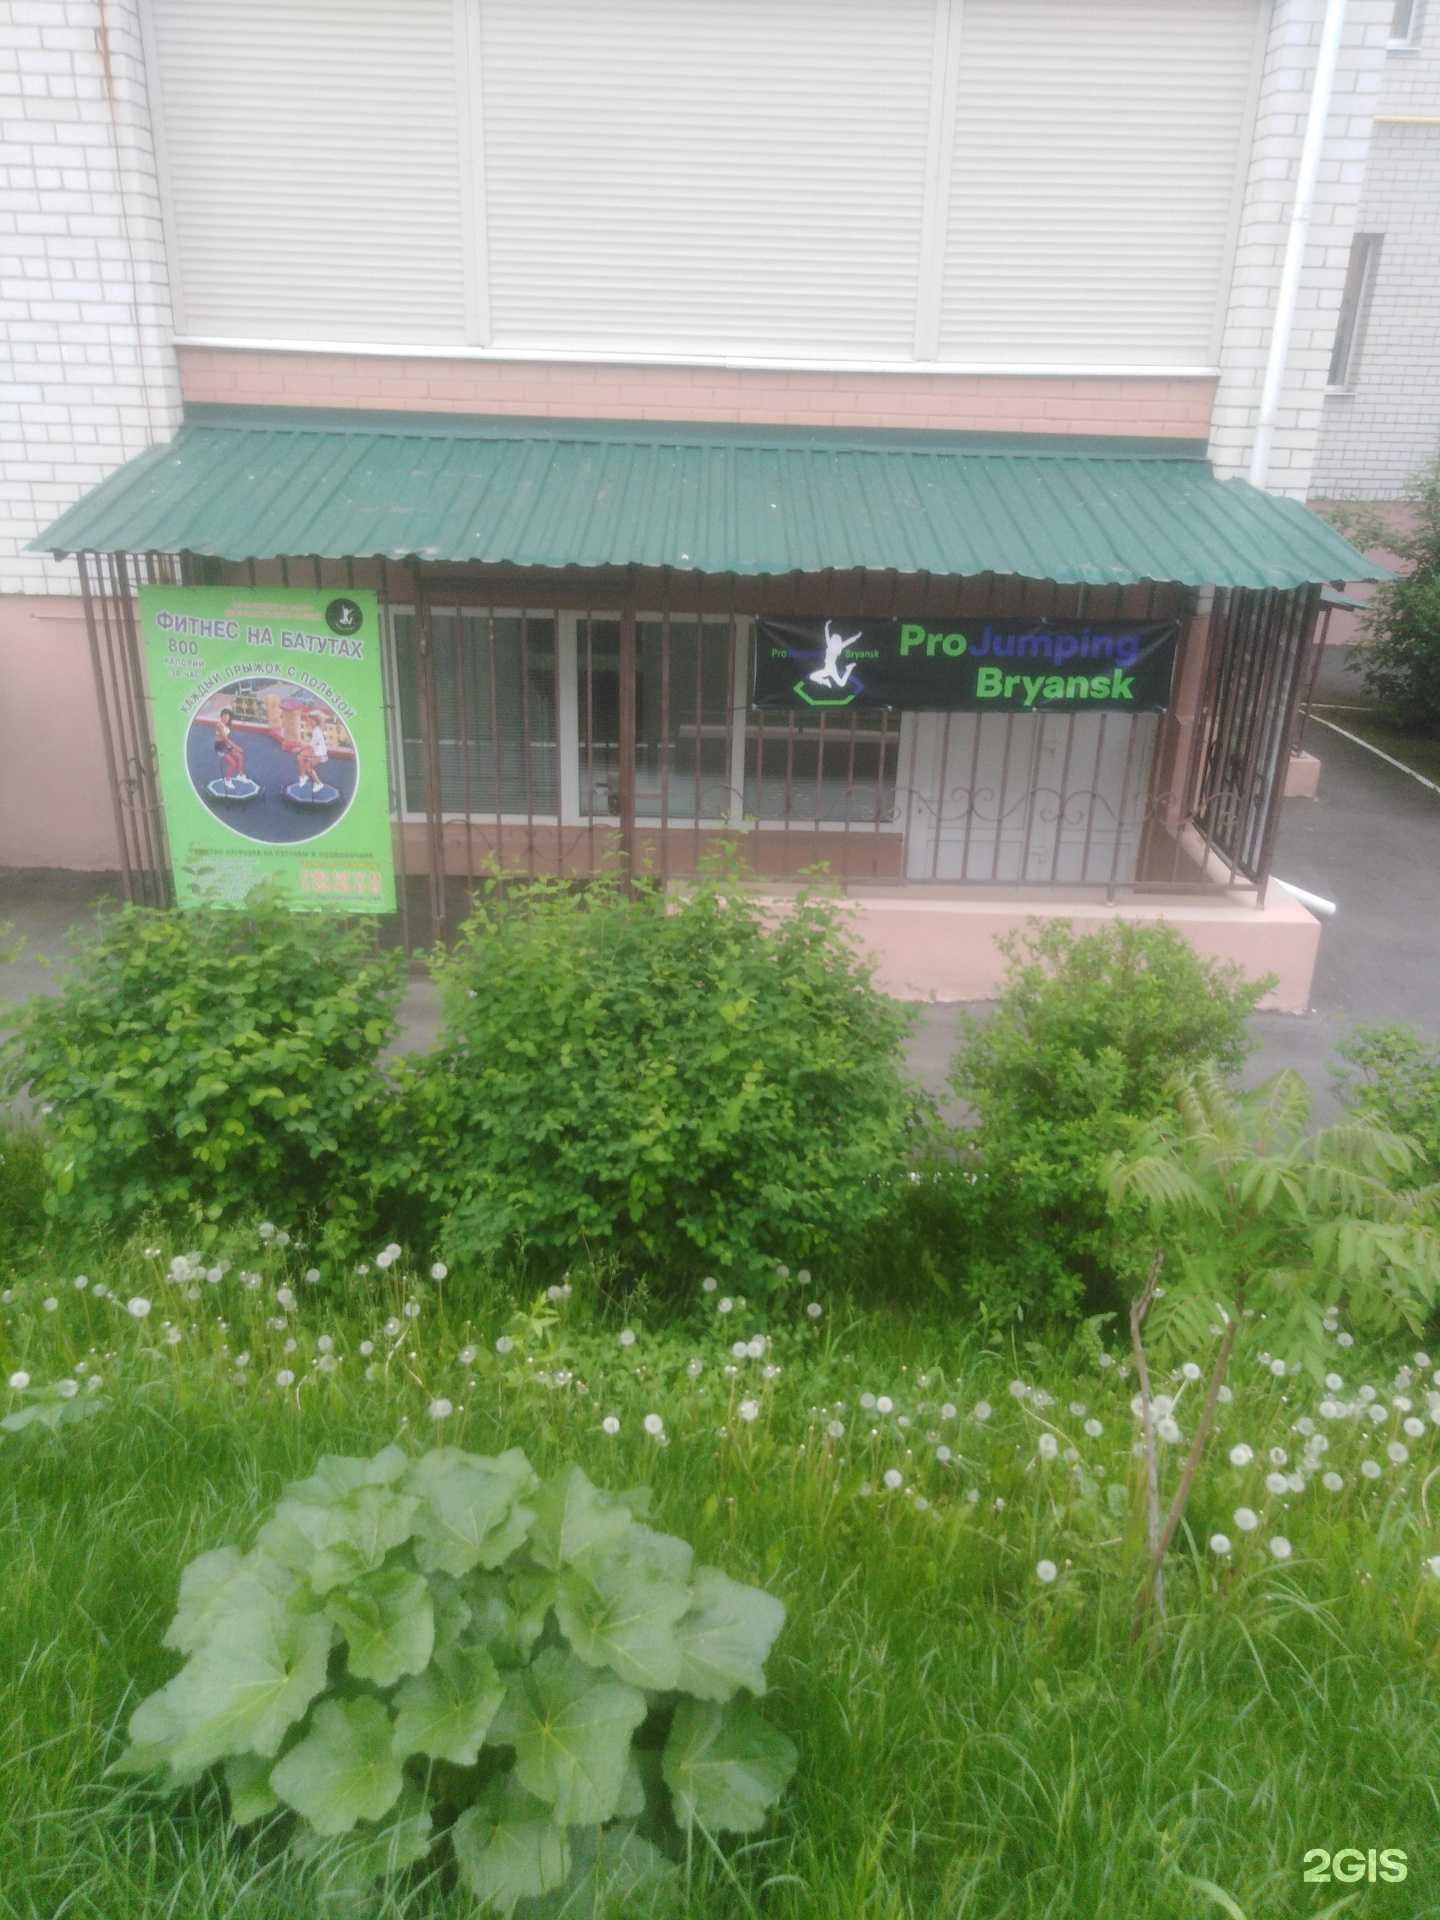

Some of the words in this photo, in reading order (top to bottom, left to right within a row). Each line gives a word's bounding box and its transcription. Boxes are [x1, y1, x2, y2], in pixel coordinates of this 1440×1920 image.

[156, 609, 239, 639] ФИТНЕС
[247, 627, 273, 645] НА
[281, 632, 364, 659] БАТУТАХ
[168, 638, 198, 656] 800
[771, 648, 787, 658] Pro
[845, 649, 880, 659] Bryansk
[224, 663, 281, 680] ПРЫЖОК
[976, 667, 1133, 706] Bryansk
